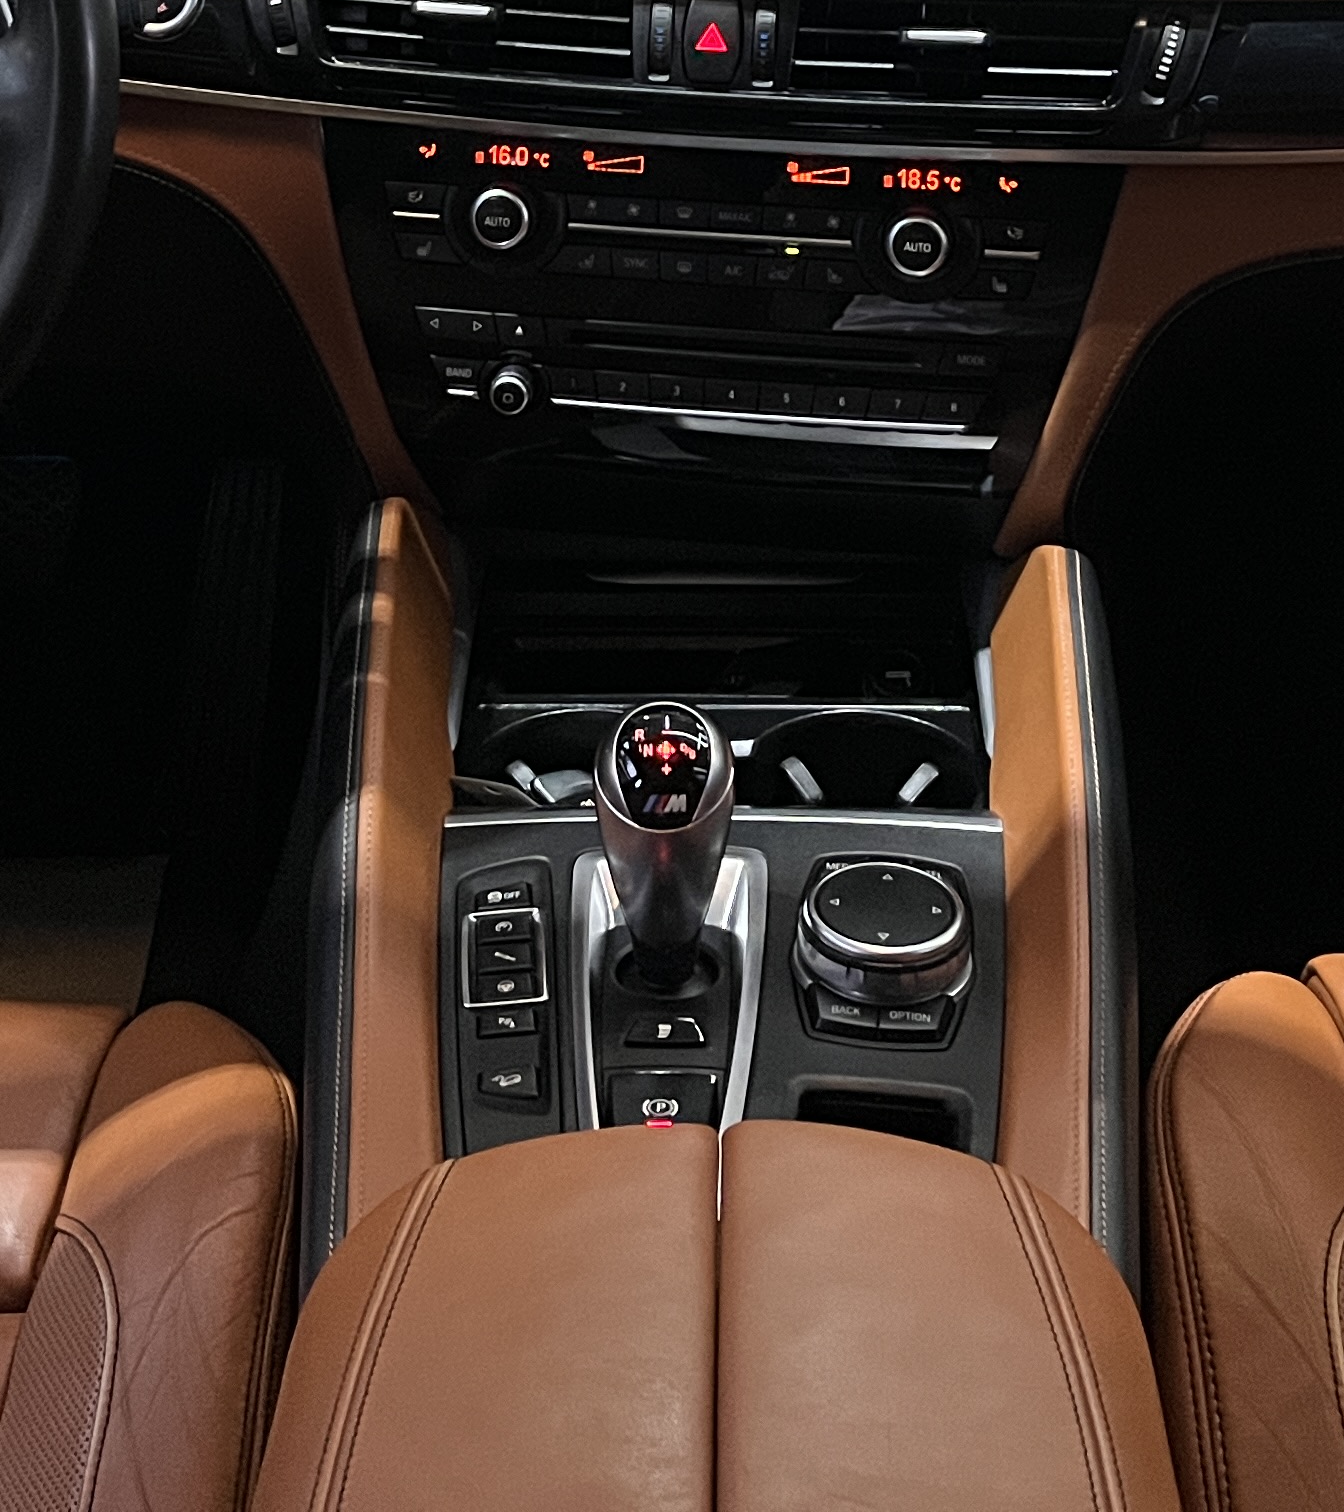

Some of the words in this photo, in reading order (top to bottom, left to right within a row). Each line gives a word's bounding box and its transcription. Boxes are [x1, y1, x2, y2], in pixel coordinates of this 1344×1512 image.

[488, 145, 529, 167] 16.0
[533, 152, 551, 168] °C
[896, 168, 940, 191] 18.5
[943, 176, 962, 193] °C
[484, 216, 511, 228] AUTO
[903, 241, 932, 254] AUTO
[623, 256, 649, 268] SYNC
[957, 354, 986, 367] MODE
[445, 366, 473, 379] BAND
[570, 377, 576, 388] 1
[619, 381, 626, 392] 2
[673, 385, 681, 396] 3
[728, 388, 735, 399] 4
[783, 392, 790, 403] 5
[838, 395, 846, 407] 6
[894, 398, 901, 409] 7
[634, 728, 646, 742] R
[642, 743, 654, 758] N
[503, 890, 521, 900] OFF
[831, 1004, 861, 1016] BACK
[889, 1010, 932, 1023] OPTION
